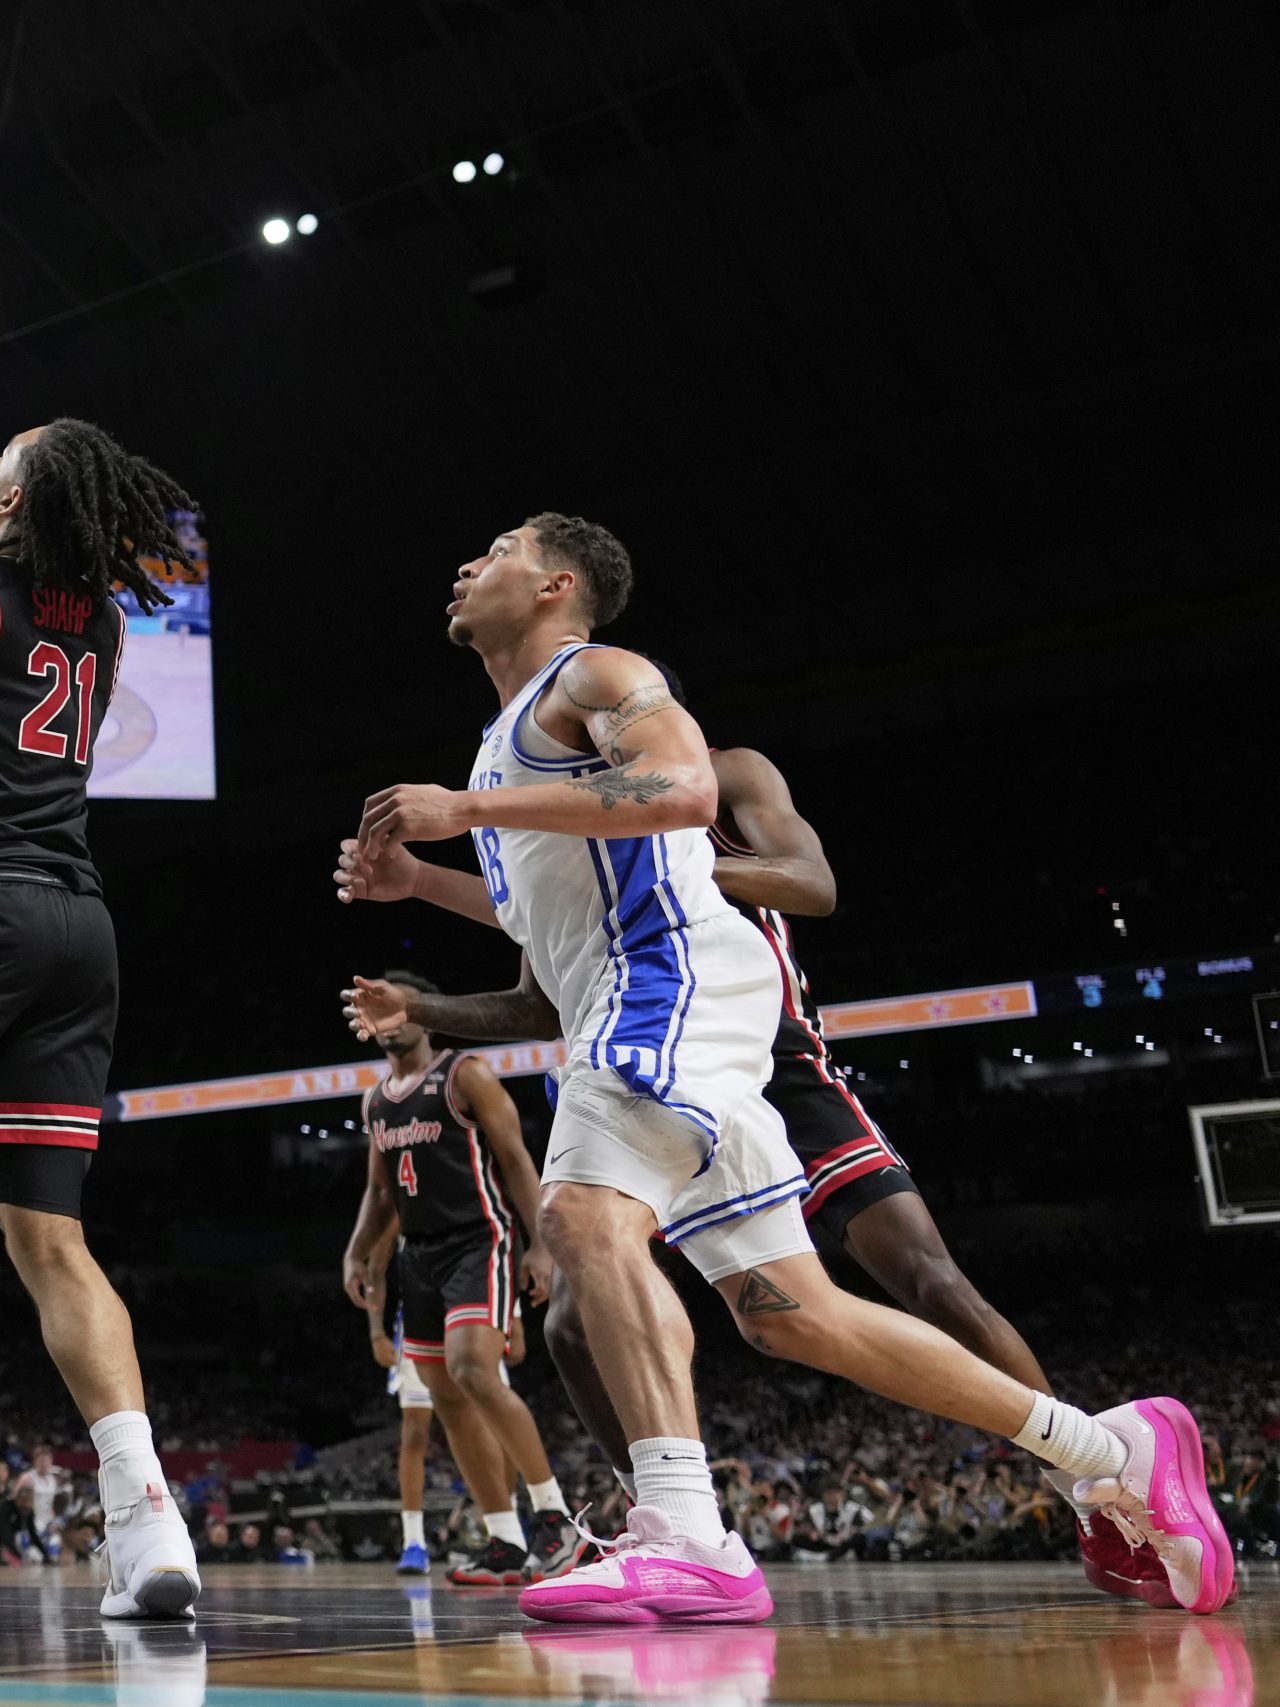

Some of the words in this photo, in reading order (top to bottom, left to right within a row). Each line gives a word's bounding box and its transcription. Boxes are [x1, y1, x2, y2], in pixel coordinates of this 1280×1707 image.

[18, 640, 96, 765] 21
[486, 1045, 568, 1074] THE
[291, 1070, 357, 1097] AND
[372, 1116, 443, 1153] Houston
[398, 1150, 418, 1197] 4
